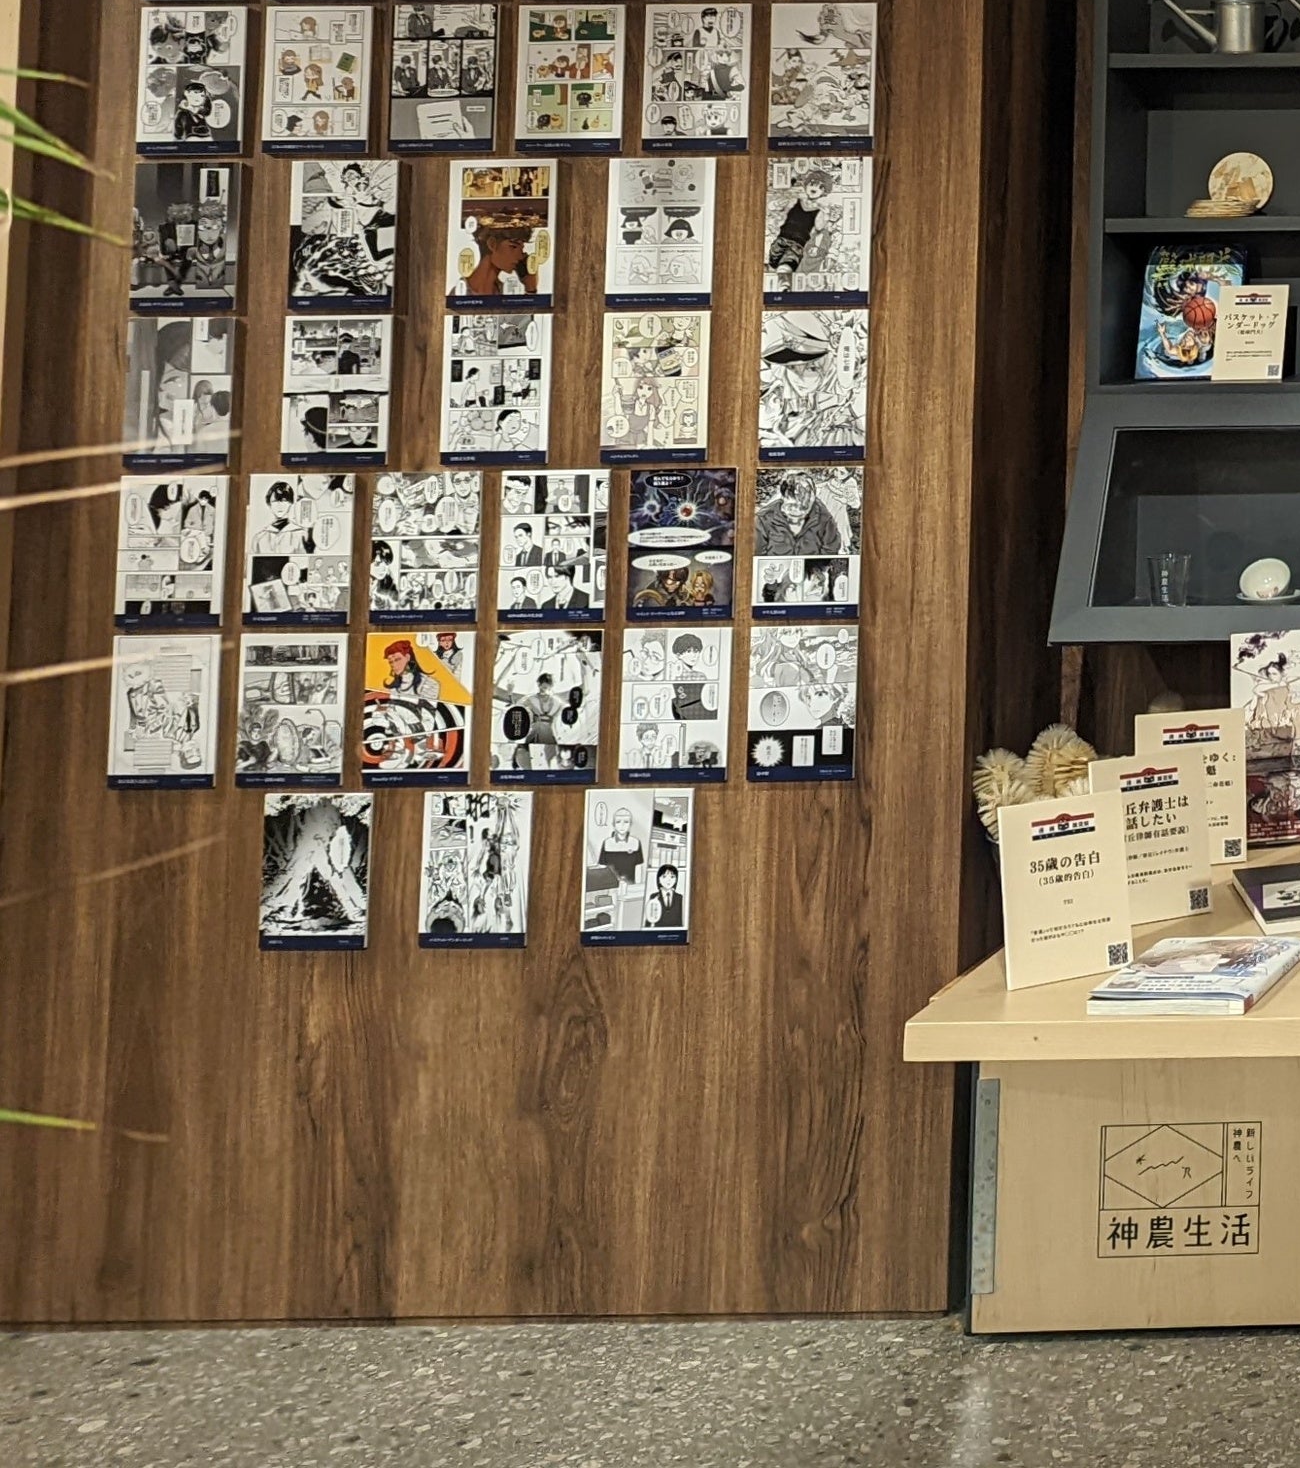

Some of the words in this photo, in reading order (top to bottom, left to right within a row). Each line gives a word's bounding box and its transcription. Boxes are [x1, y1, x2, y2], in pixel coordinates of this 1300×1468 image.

[1126, 813, 1177, 831] 話したい
[1029, 850, 1101, 874] 35歳の告白
[1232, 1127, 1243, 1163] 神農へ
[1245, 1127, 1256, 1200] 新しいライフ
[1106, 1213, 1251, 1250] 神農生活
